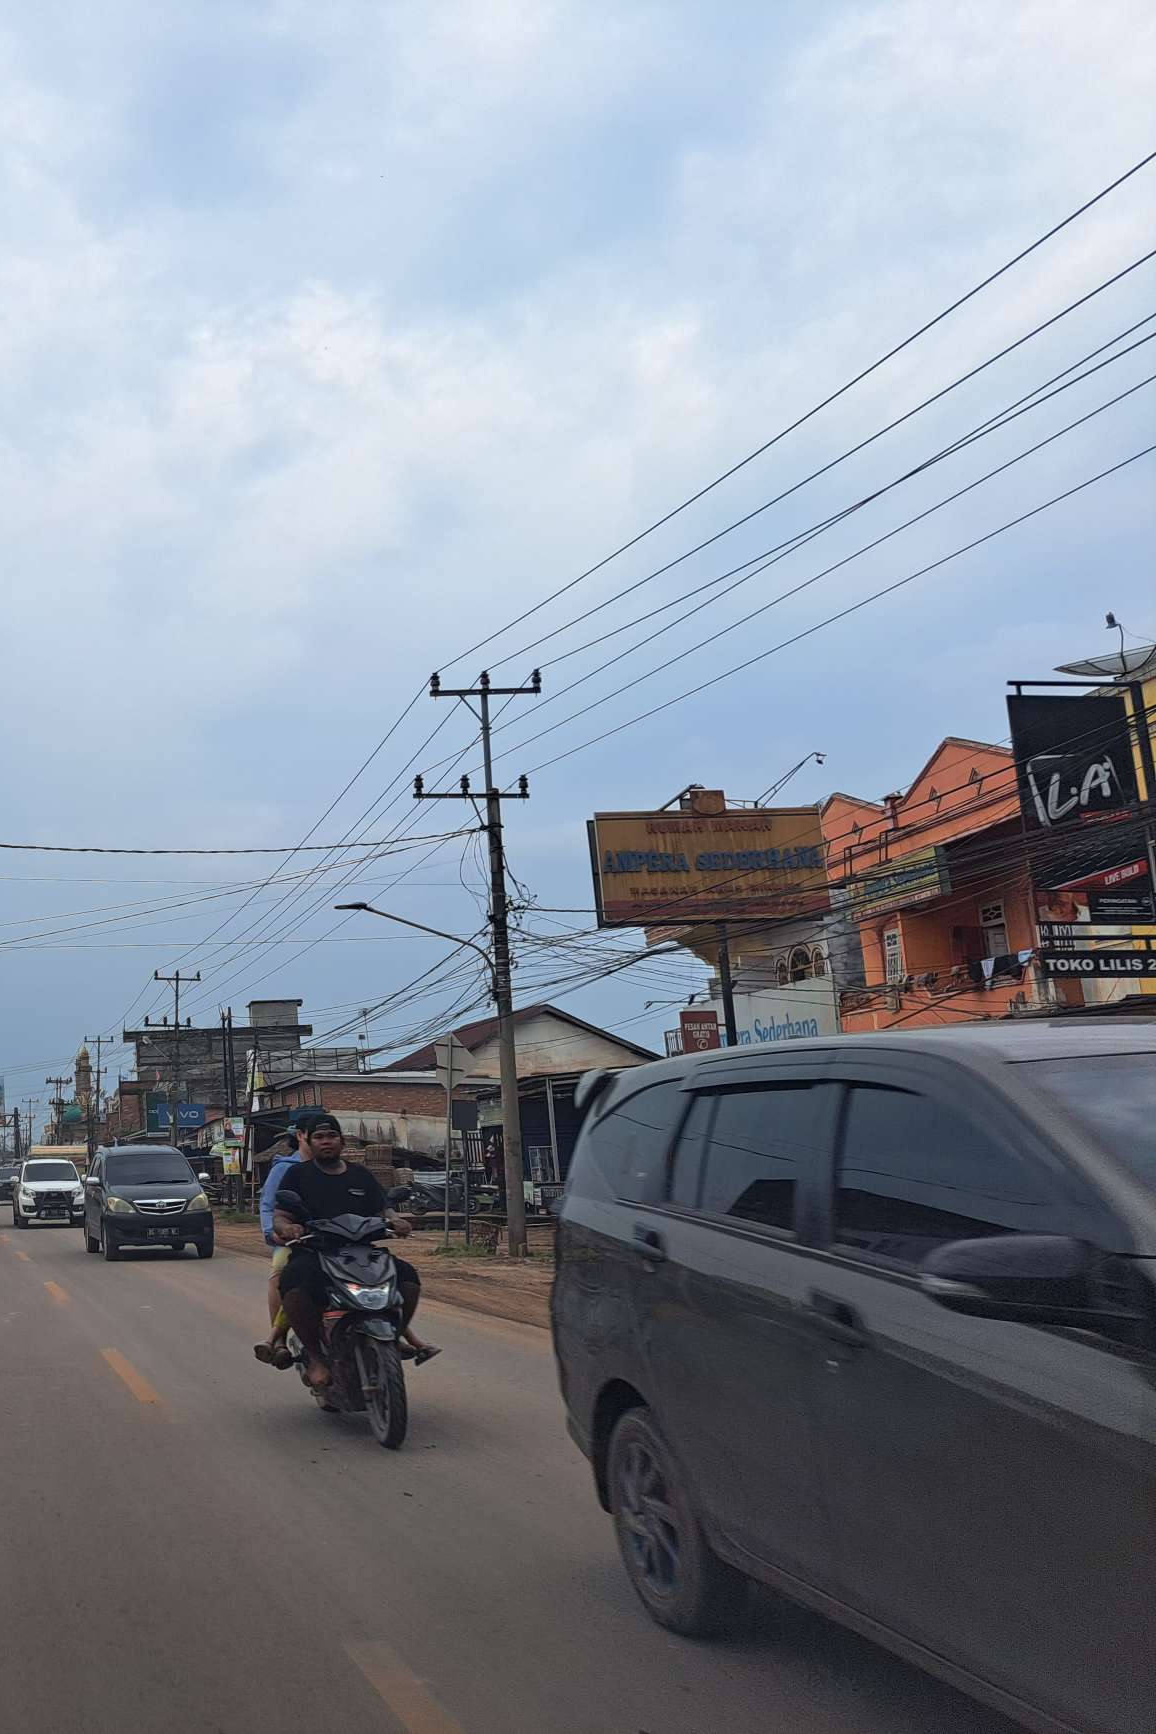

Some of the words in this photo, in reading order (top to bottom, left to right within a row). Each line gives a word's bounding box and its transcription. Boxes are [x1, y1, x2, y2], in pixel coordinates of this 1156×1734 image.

[603, 849, 690, 874] AMPERA
[695, 846, 824, 871] SEDERHANA
[1046, 959, 1095, 971] TOKO
[1098, 958, 1144, 971] LILIS
[754, 1012, 820, 1044] Sederhana
[166, 1110, 199, 1120] vvo
